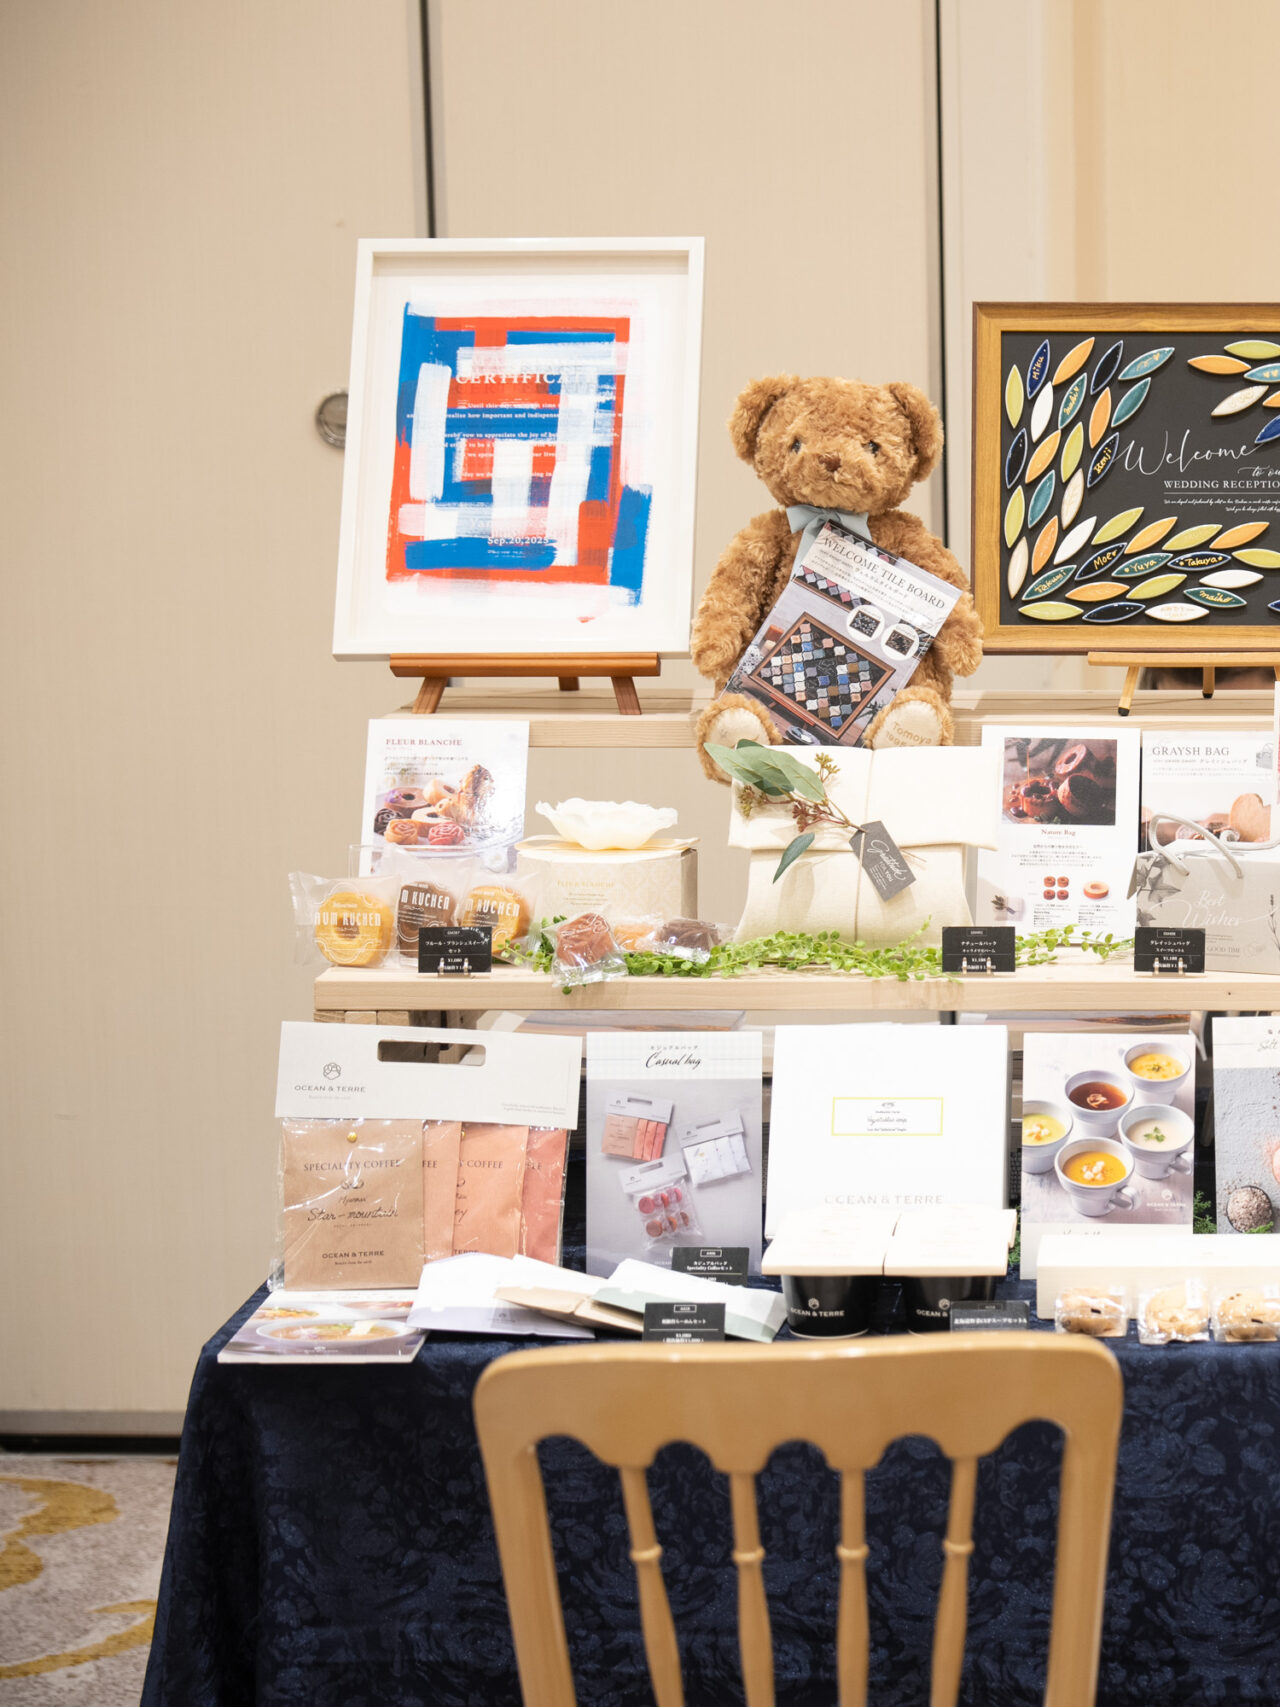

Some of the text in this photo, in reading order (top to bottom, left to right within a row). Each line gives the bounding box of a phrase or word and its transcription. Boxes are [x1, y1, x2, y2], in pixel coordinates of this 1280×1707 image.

[1112, 429, 1264, 475] Welcome
[1164, 480, 1219, 489] WEDDING
[823, 537, 878, 575] WELCOME
[880, 568, 906, 588] TILE
[907, 584, 945, 610] BOARD
[385, 738, 463, 746] FLEUR BLANCHE
[1152, 746, 1230, 756] GRAYSH BAG
[412, 890, 451, 910] KUCHEN
[343, 911, 381, 927] KUCHEN
[645, 1051, 702, 1070] Casual bag
[467, 1160, 503, 1169] COFFEE
[895, 1195, 943, 1204] TERRE
[790, 1307, 811, 1316] OCEAN
[916, 1309, 941, 1317] OCEAN
